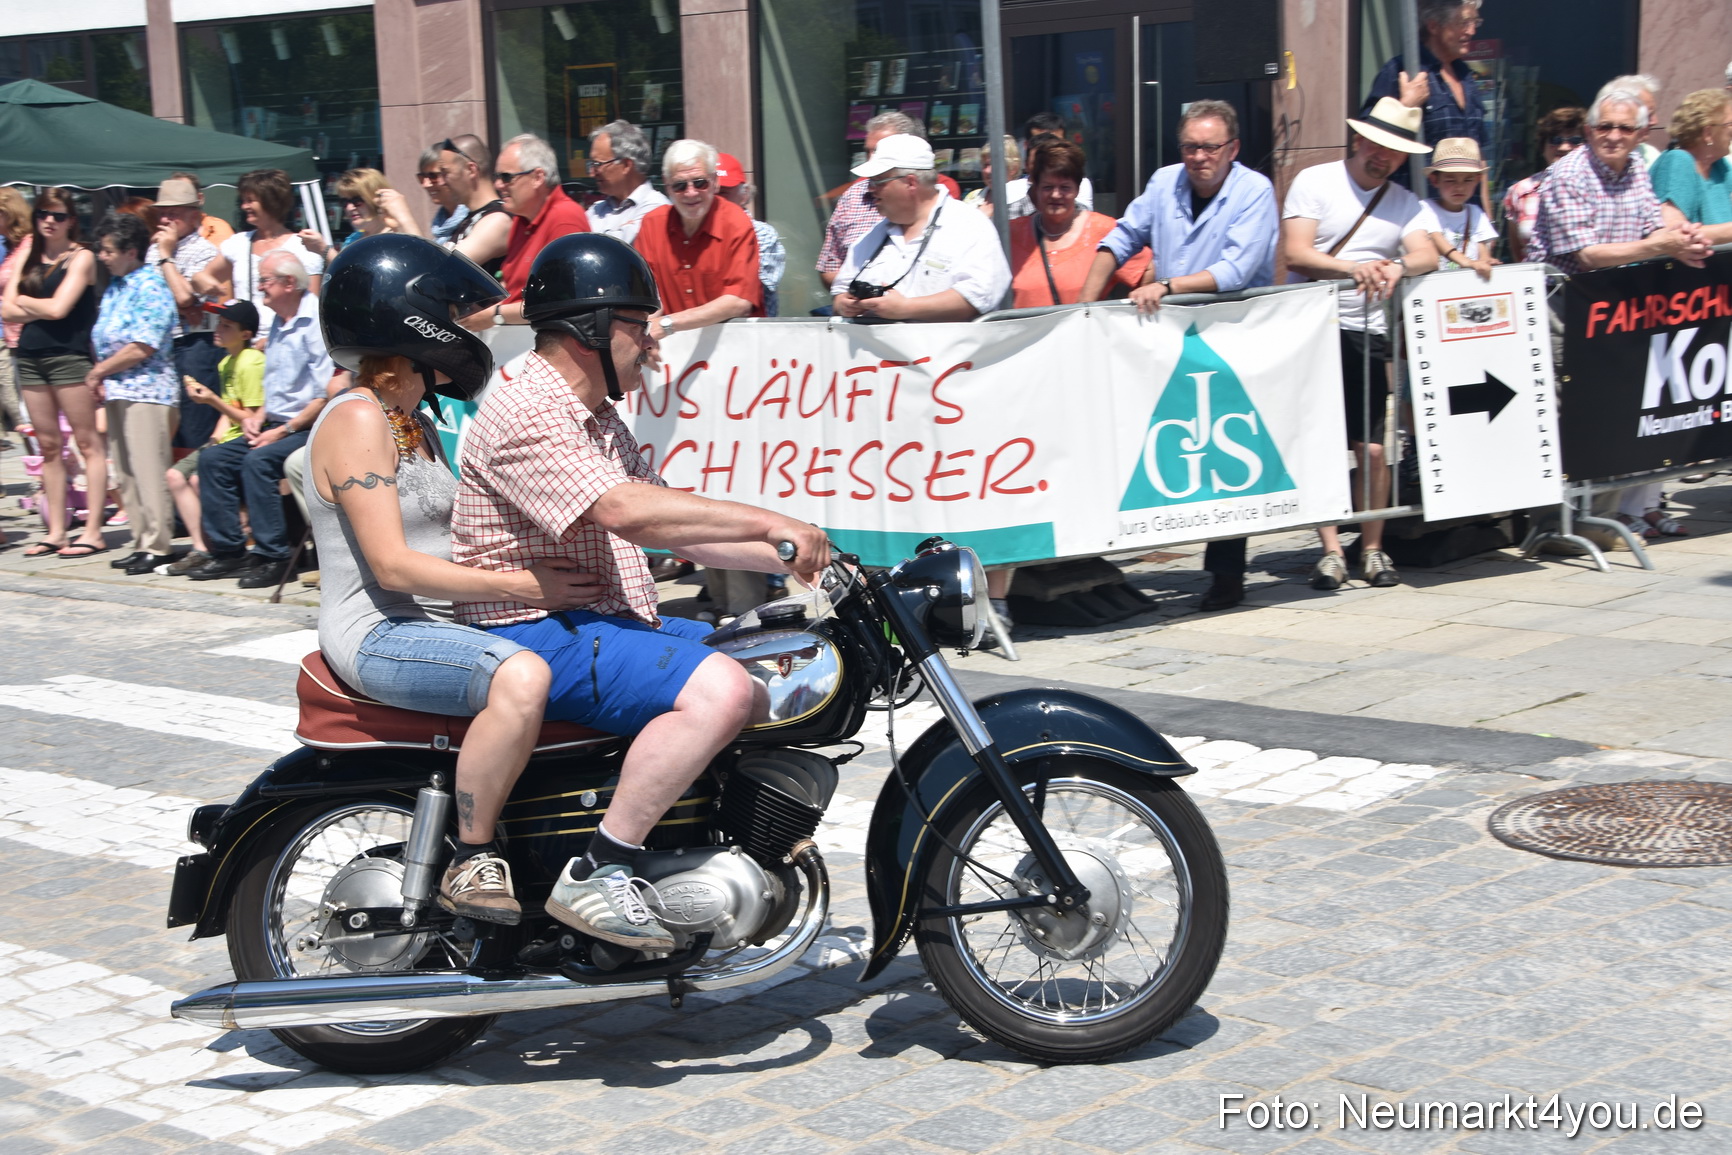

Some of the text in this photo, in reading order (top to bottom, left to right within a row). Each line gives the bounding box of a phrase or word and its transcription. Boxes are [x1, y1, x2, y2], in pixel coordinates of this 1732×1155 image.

[1412, 298, 1445, 494] RESIDENZPLATZ
[1524, 286, 1553, 479] RESIDENZPLATZ
[760, 437, 1048, 502] BESSER.
[1118, 497, 1300, 536] Jura Gebäude Service GmbH
